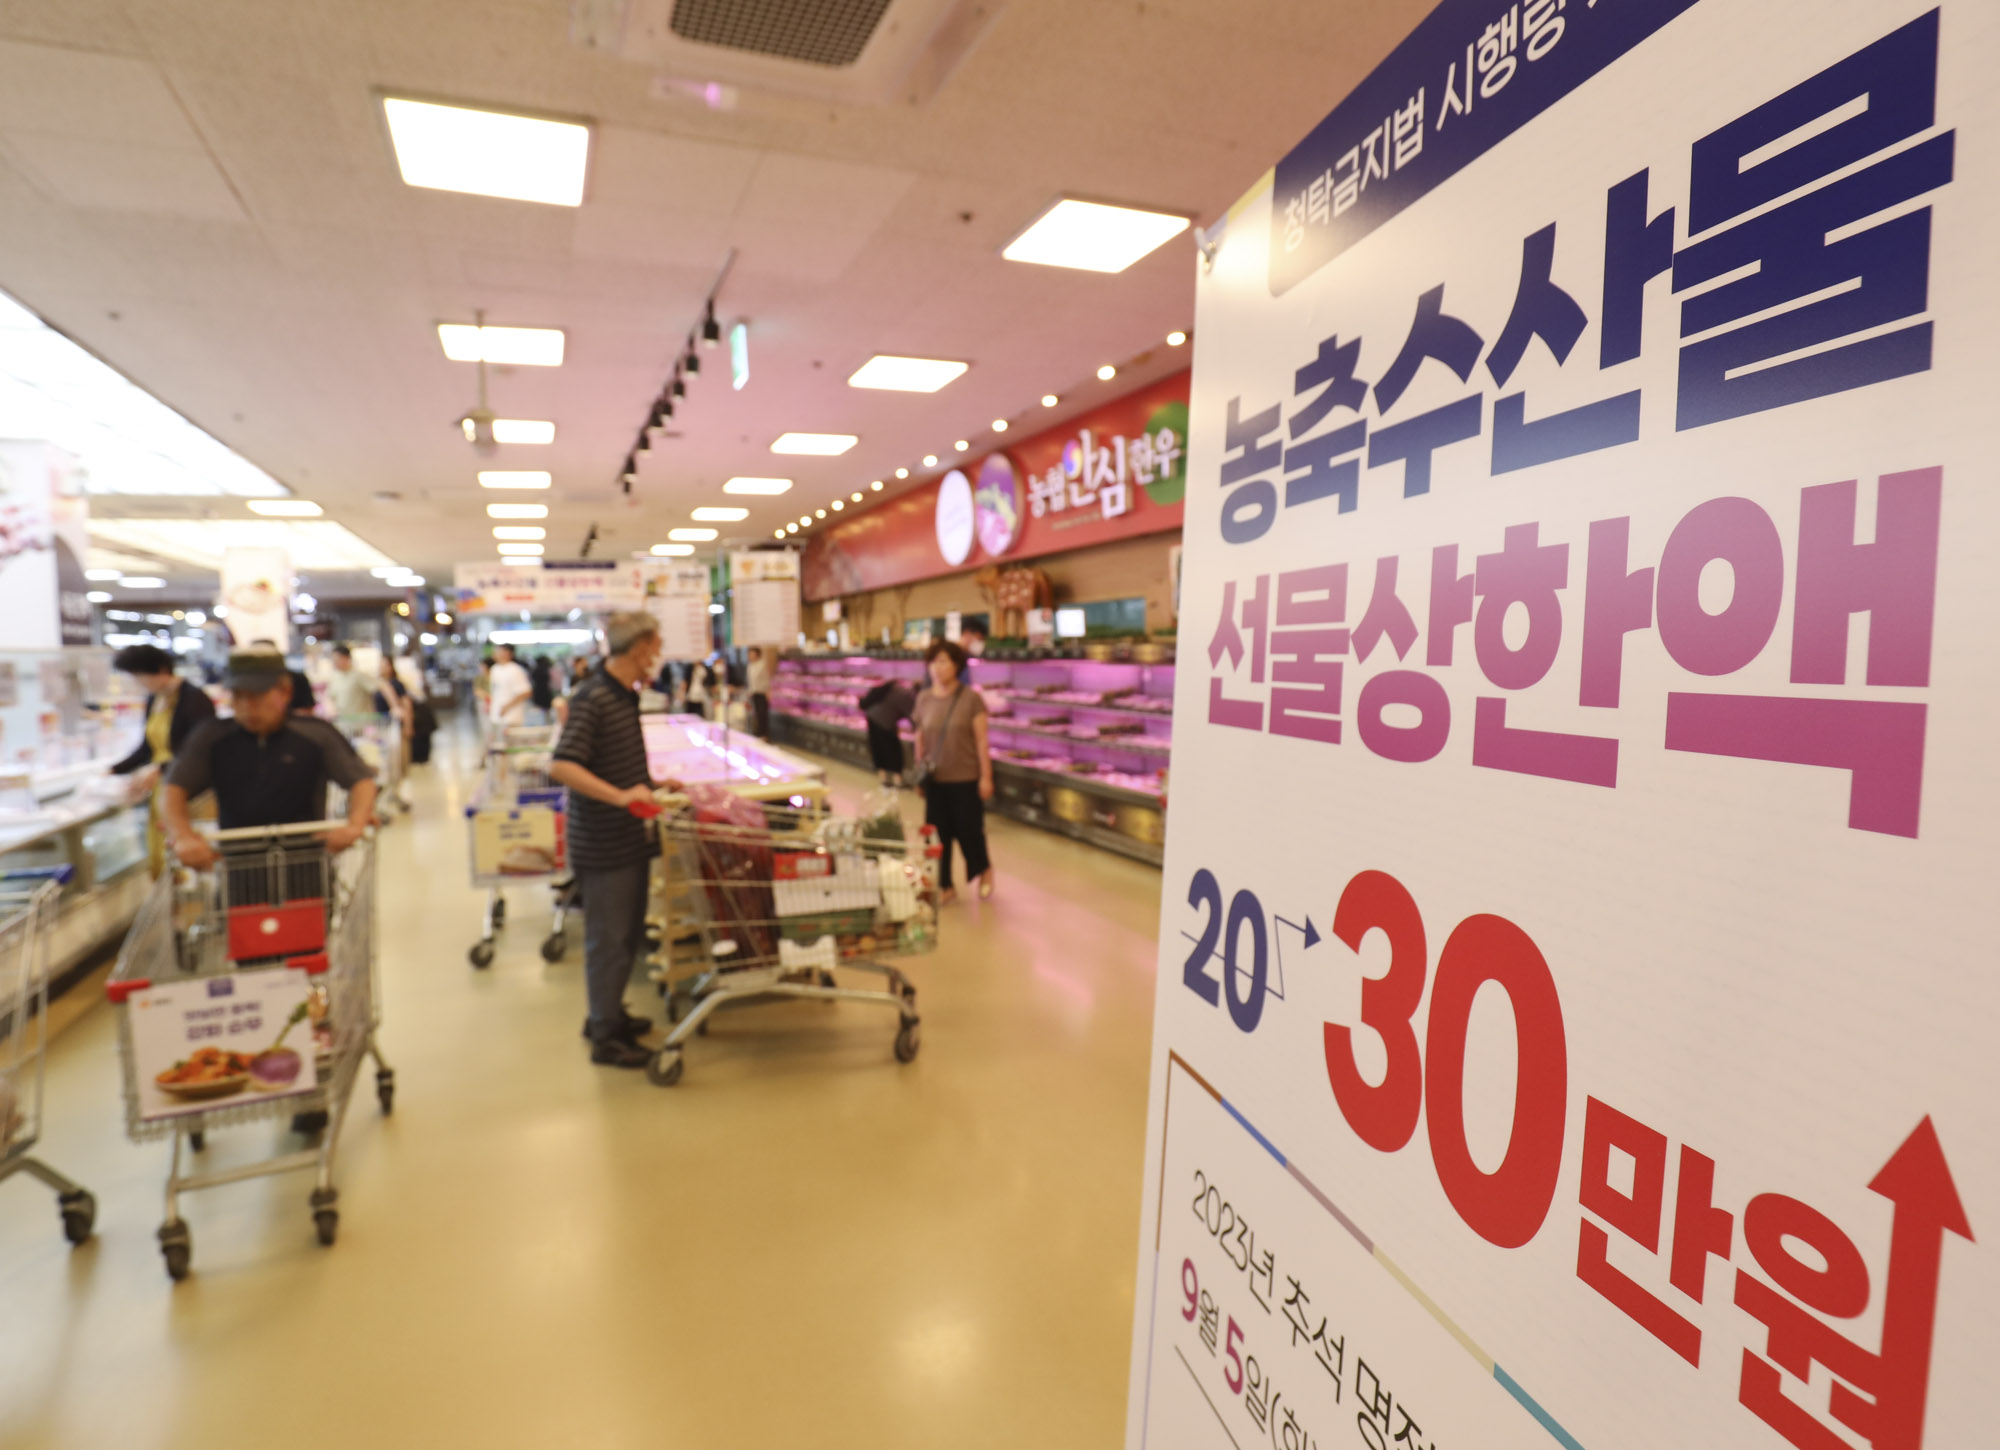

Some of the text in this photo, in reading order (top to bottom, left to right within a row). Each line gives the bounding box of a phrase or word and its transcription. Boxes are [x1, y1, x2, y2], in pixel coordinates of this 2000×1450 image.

[1282, 88, 1425, 253] 청탁금지법
[1219, 5, 1957, 545] 농축수산물
[1207, 465, 1944, 840] 선물상한액
[1183, 868, 1269, 1034] 20
[1181, 1257, 1220, 1358] 9월
[1191, 1169, 1276, 1315] 2023년
[1281, 1274, 1346, 1405] 추석
